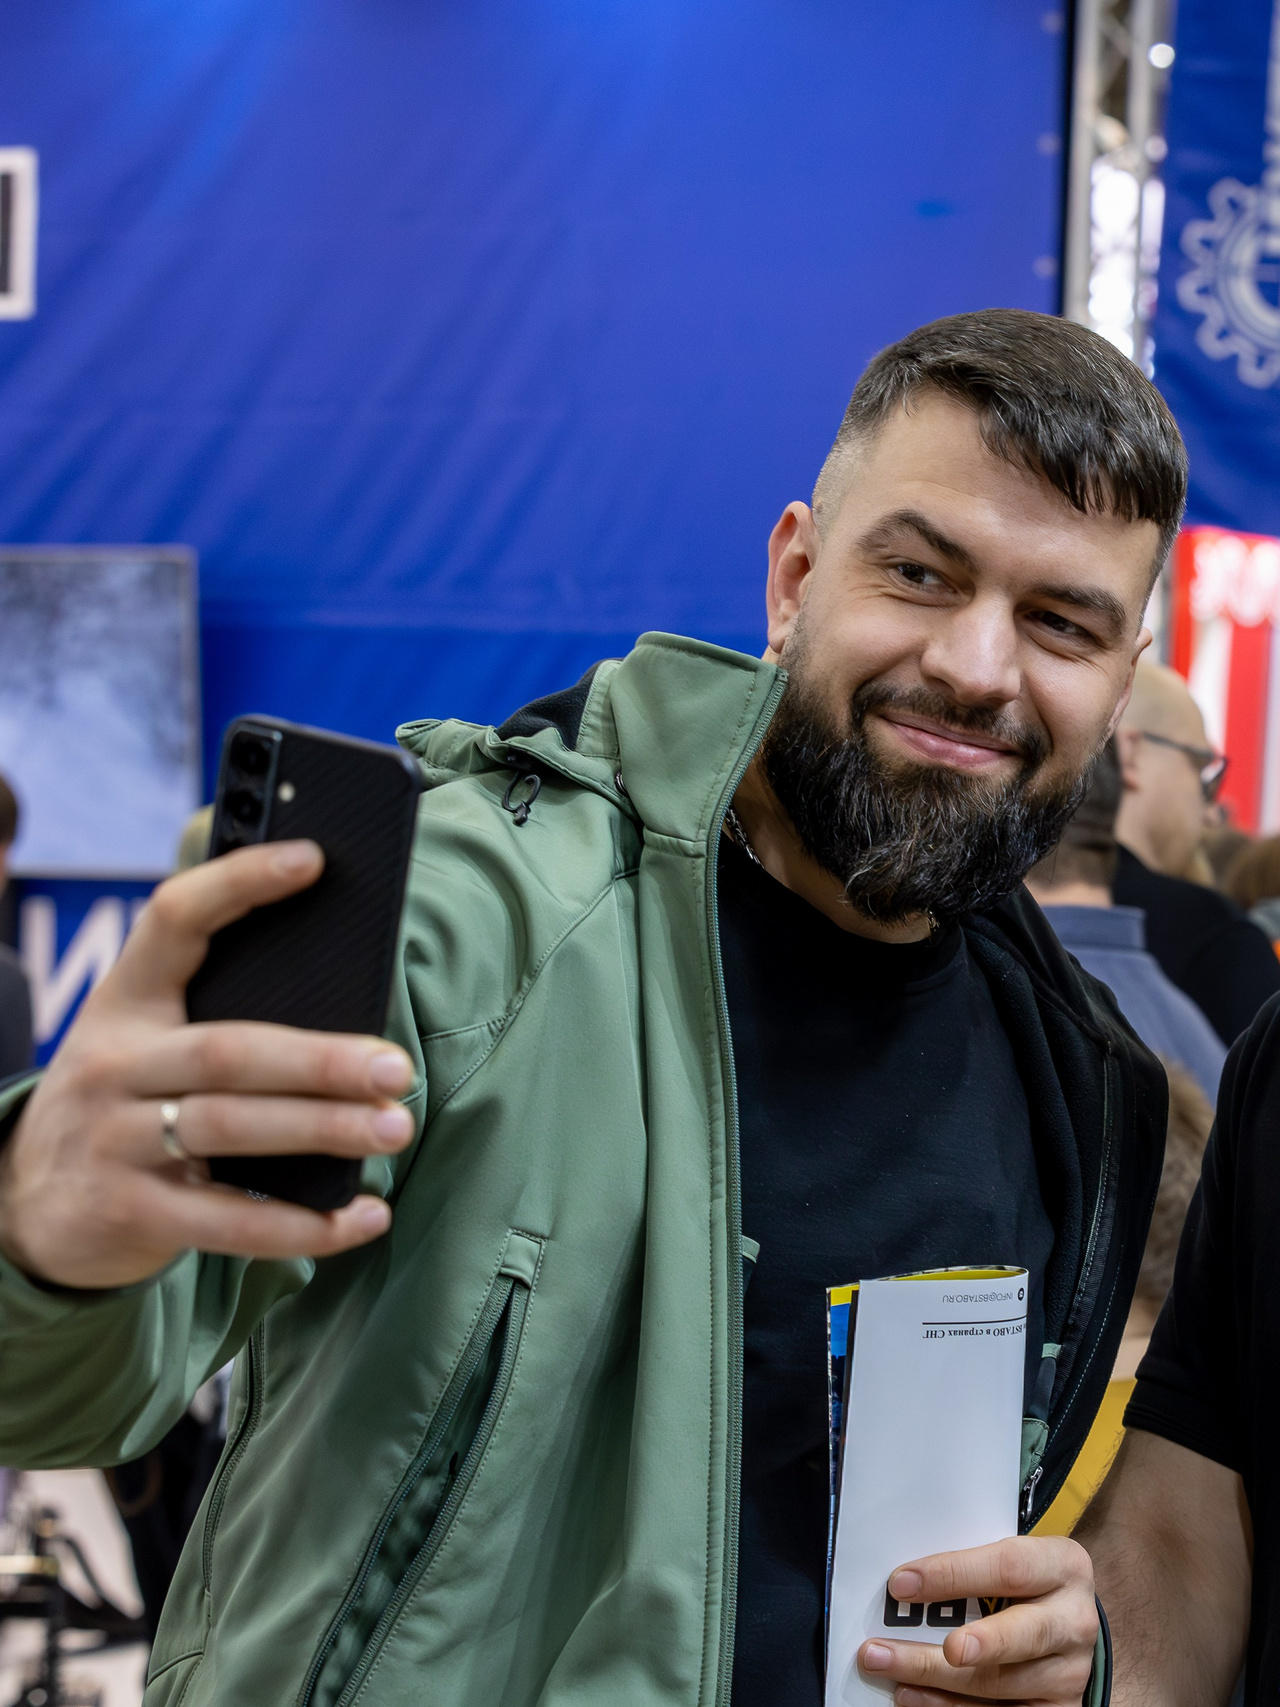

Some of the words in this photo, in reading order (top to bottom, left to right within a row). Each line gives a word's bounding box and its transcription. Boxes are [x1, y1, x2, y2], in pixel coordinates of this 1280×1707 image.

[942, 1292, 1013, 1303] INFO@BSTABO.RU
[922, 1329, 946, 1339] СНГ
[947, 1327, 984, 1337] странах
[992, 1324, 1023, 1337] BSTABO
